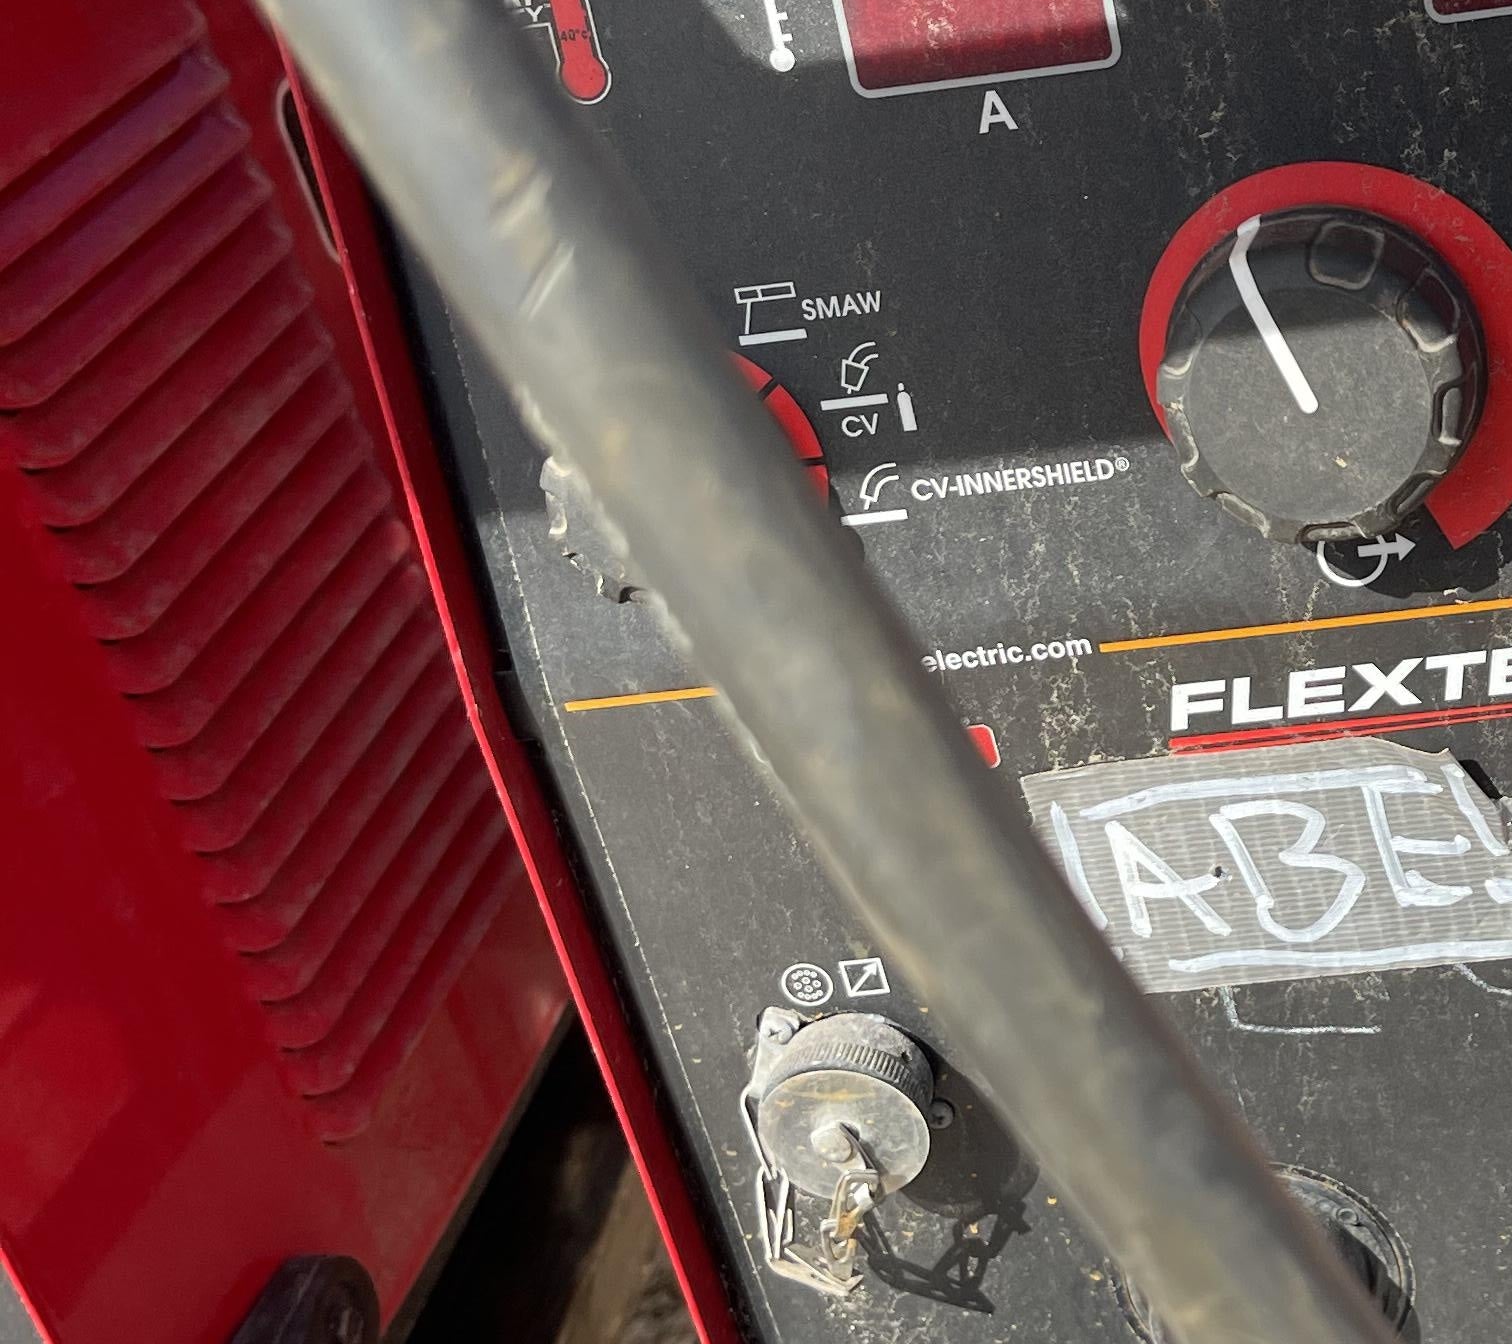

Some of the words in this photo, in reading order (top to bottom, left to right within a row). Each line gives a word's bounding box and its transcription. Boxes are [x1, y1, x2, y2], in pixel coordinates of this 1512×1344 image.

[979, 90, 1018, 134] A
[800, 289, 882, 322] SMAW
[840, 412, 879, 439] CV
